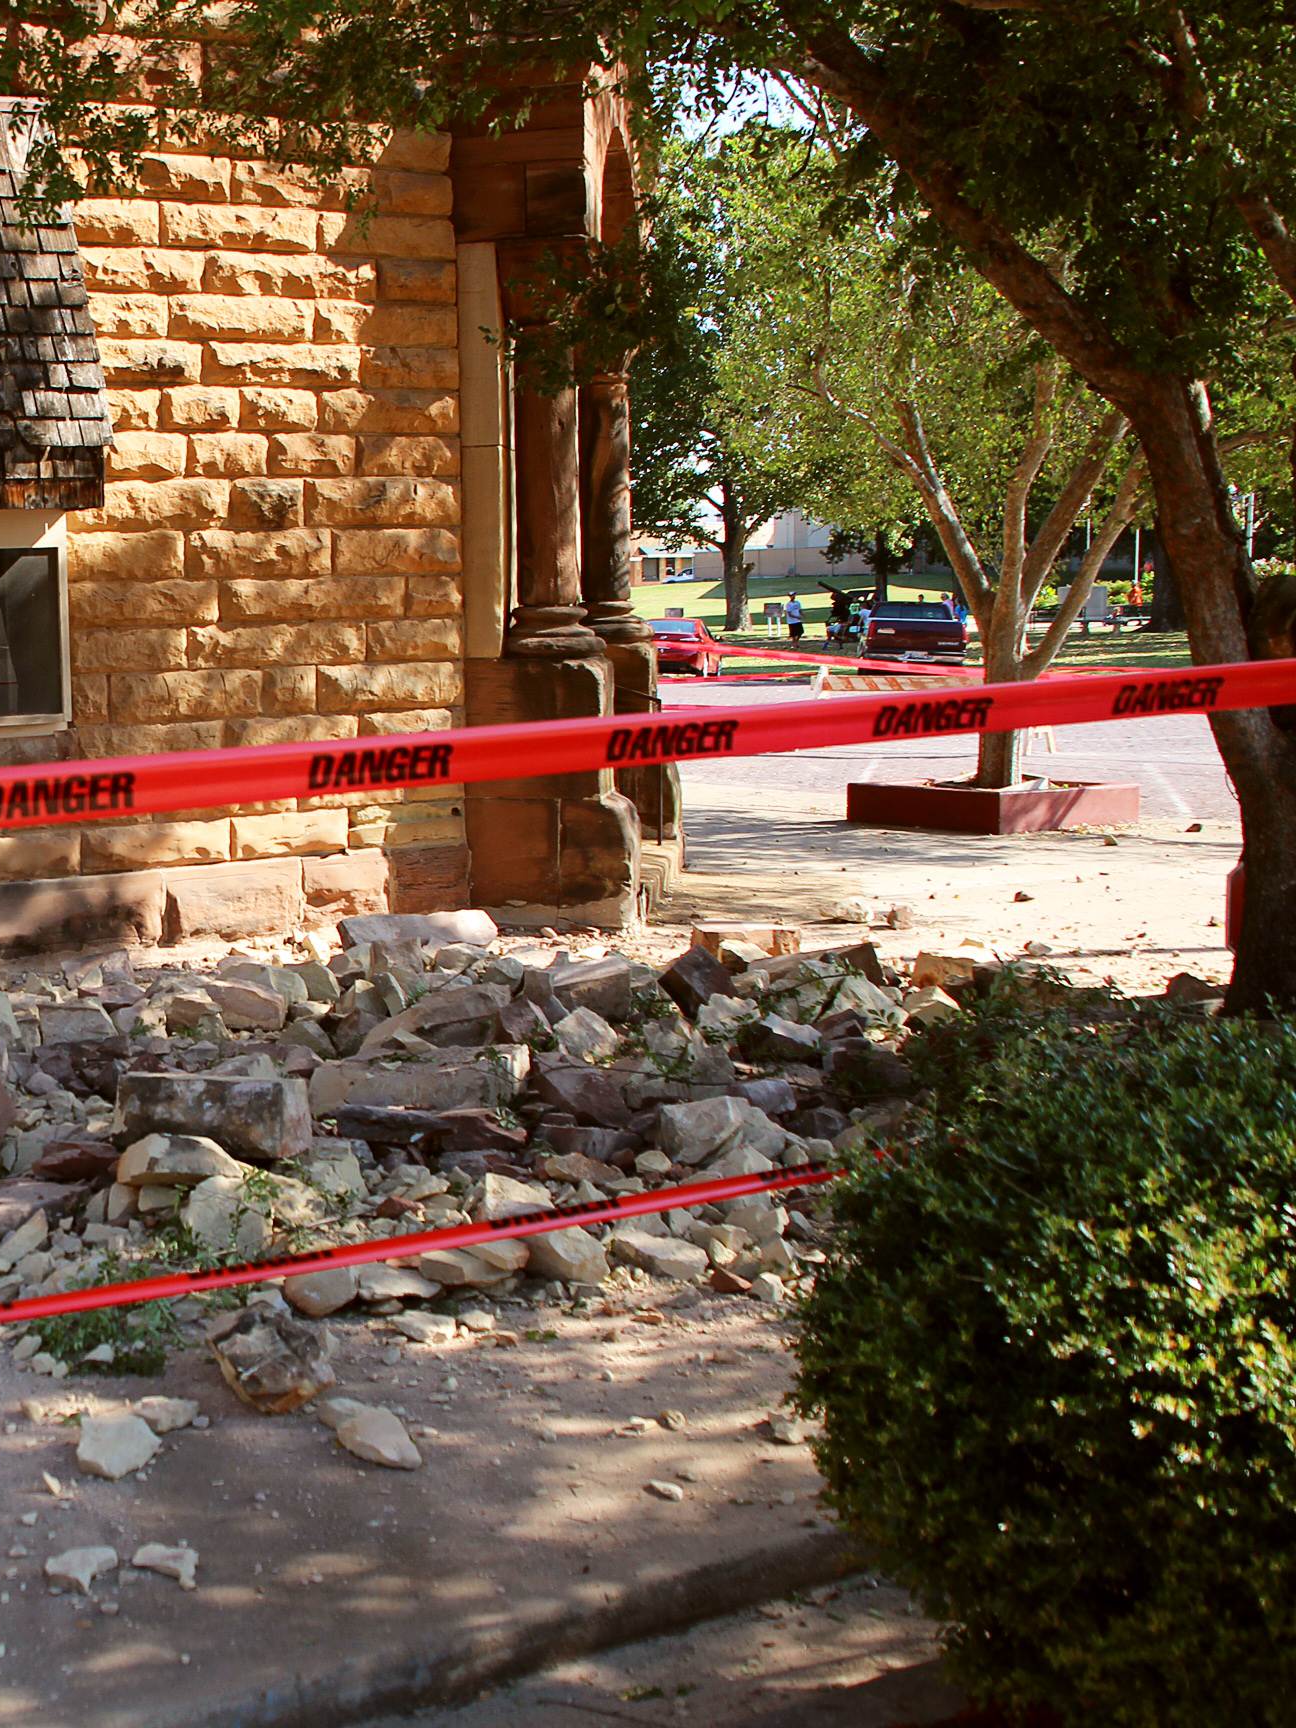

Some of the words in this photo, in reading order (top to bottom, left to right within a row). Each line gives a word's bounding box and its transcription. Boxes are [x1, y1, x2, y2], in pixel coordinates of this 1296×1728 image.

[307, 743, 454, 790] DANGER
[606, 719, 740, 762] DANGER
[873, 696, 993, 736] DANGER
[1112, 676, 1224, 715] DANGER
